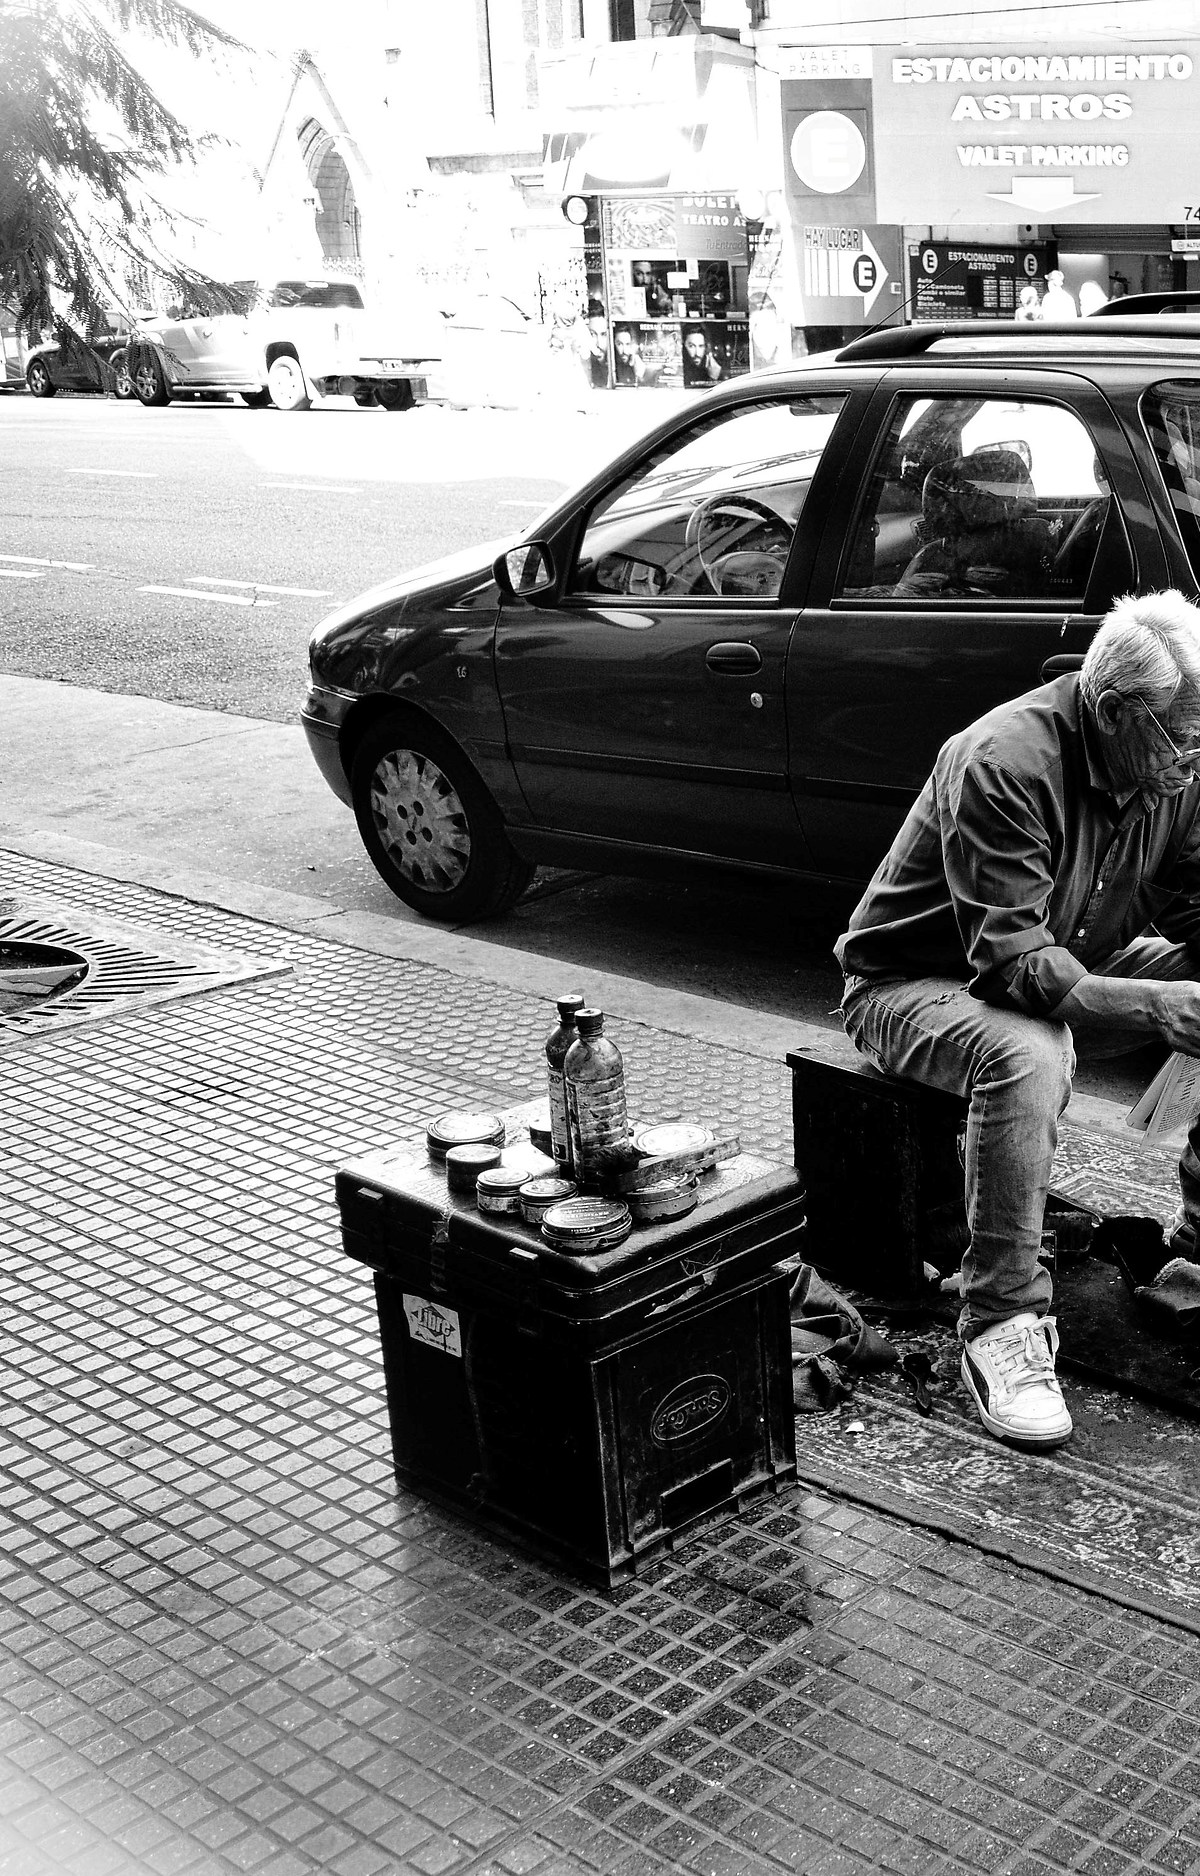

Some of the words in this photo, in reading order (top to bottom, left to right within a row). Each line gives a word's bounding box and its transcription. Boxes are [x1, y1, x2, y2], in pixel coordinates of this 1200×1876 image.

[799, 50, 848, 60] VALET
[789, 64, 861, 74] PARKING
[892, 54, 1194, 83] ESTACIONAMIENTO
[951, 93, 1133, 121] ASTROS
[811, 128, 849, 176] E
[956, 145, 1027, 167] VALET
[1031, 144, 1129, 167] PARKING
[682, 214, 729, 227] TEATRO
[804, 225, 826, 249] HAY
[826, 227, 861, 251] LUGAR
[948, 251, 1015, 263] ESTACIONAMIENTO
[968, 261, 997, 271] ASTROS
[858, 261, 873, 287] E
[417, 1306, 452, 1338] Libre
